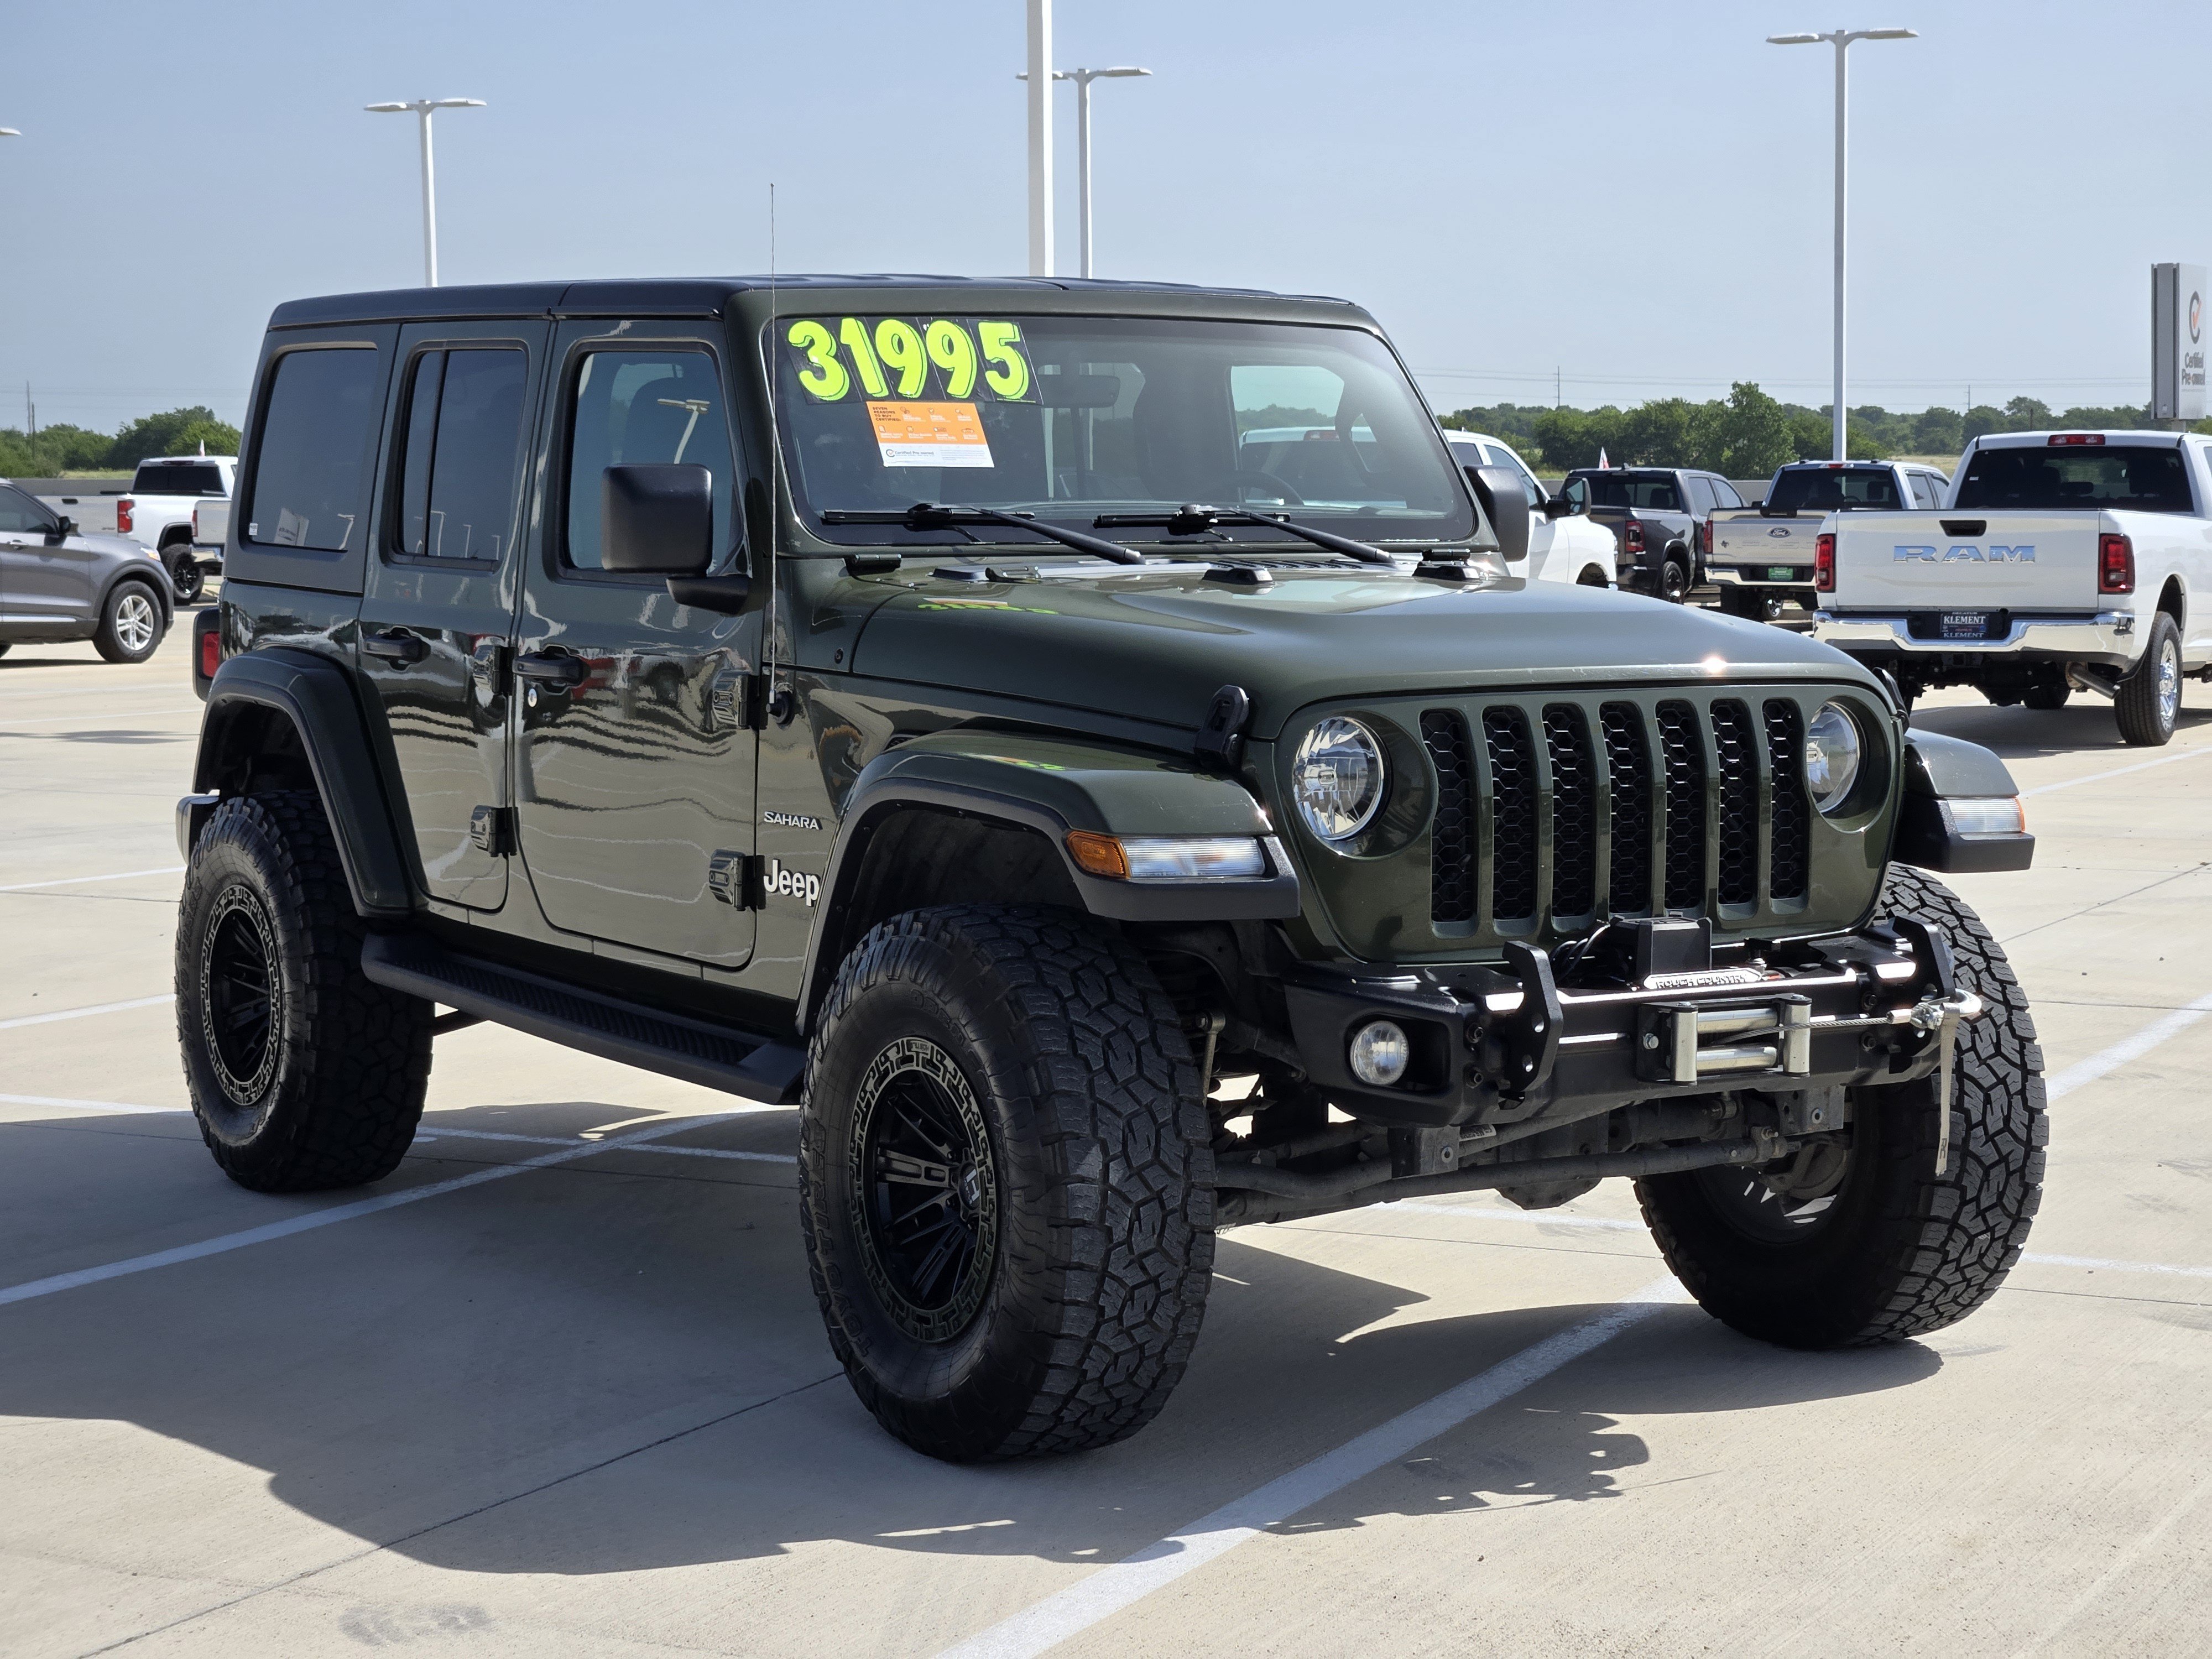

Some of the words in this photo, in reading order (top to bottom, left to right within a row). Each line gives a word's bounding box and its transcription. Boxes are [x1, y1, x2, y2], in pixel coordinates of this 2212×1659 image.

[788, 317, 1029, 401] 31995
[1893, 545, 2036, 563] RAM
[1943, 615, 1986, 624] KLEMENT
[764, 811, 822, 830] SAHARA
[764, 859, 820, 906] Jeep
[1655, 978, 1696, 989] ROUGH
[811, 1119, 835, 1256] TIRES
[825, 1264, 874, 1358] TOYO
